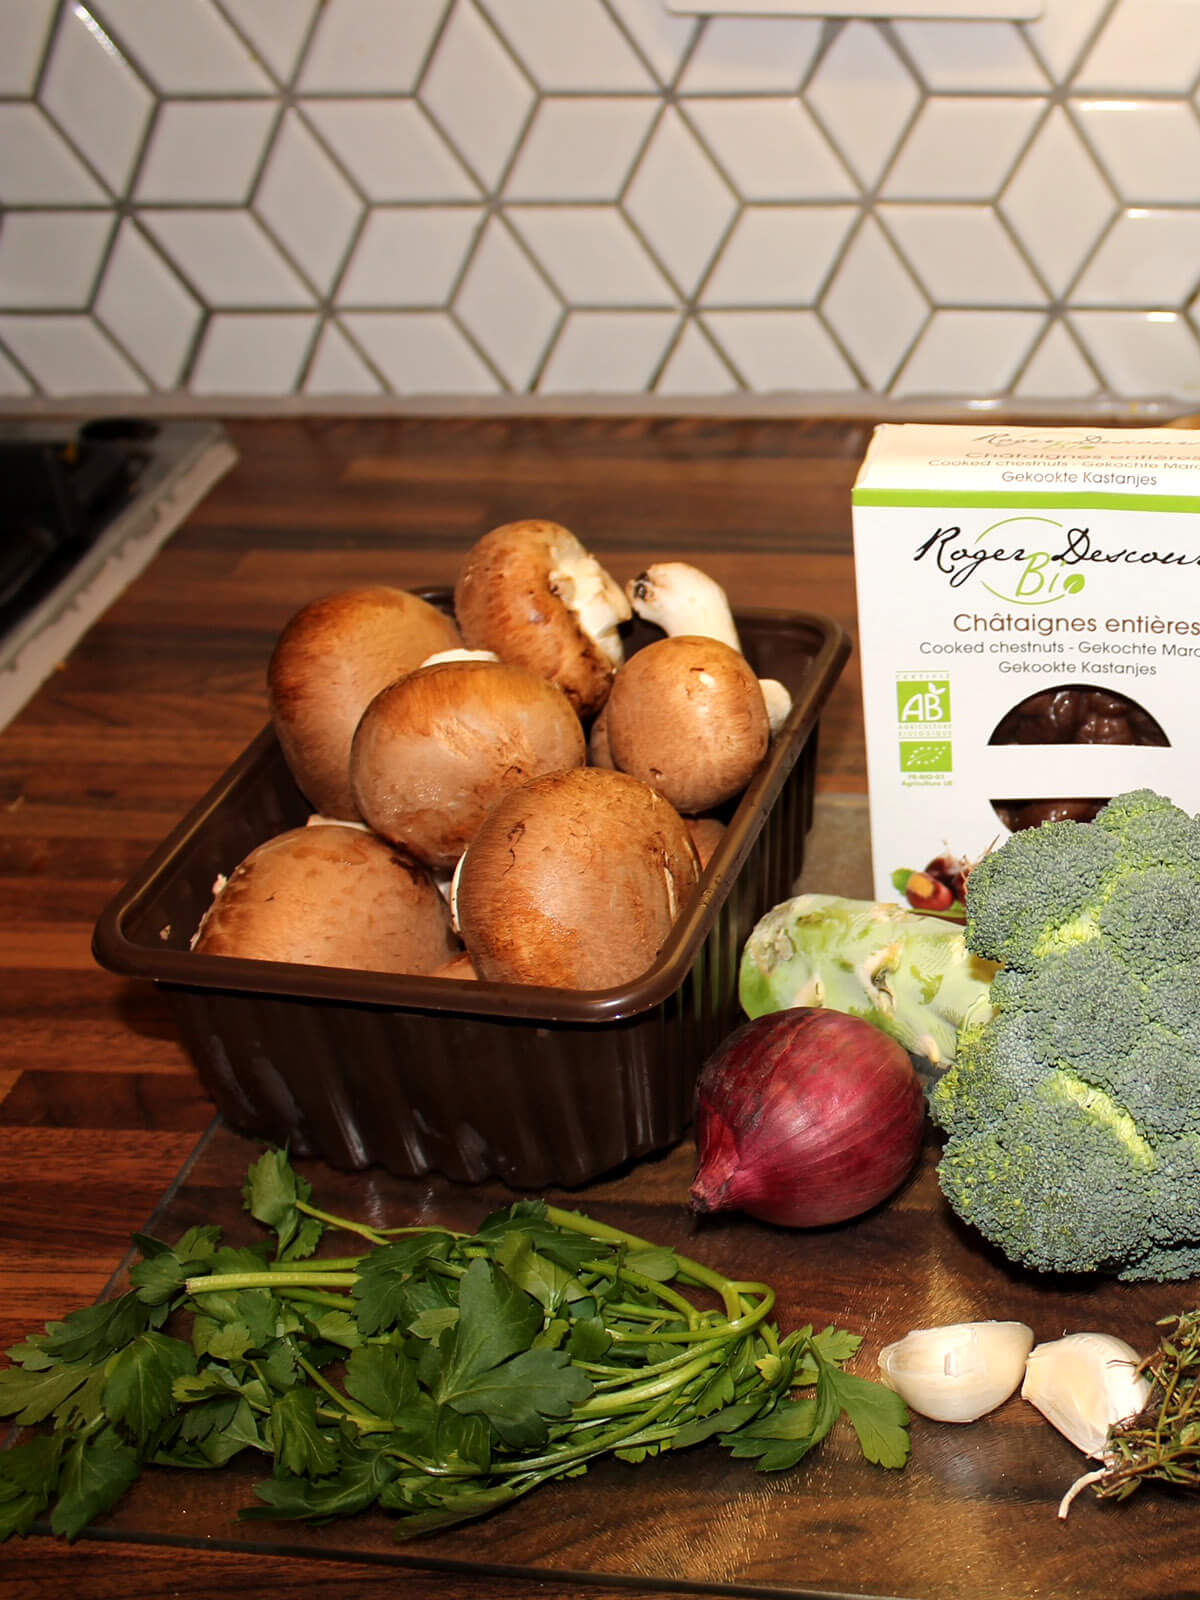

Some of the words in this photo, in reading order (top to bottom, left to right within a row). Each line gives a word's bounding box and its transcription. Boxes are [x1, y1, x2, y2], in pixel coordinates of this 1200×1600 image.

[1001, 471, 1078, 484] Gekookte
[1083, 471, 1158, 488] Kastanjes
[913, 526, 1027, 588] Roger
[953, 613, 1097, 636] Châtaignes
[1105, 615, 1200, 635] entières
[919, 641, 985, 655] Cooked
[989, 640, 1065, 654] chestnuts
[1078, 641, 1157, 656] Gekochte
[998, 660, 1077, 674] Gekookte
[1081, 661, 1157, 678] Kastanjes
[901, 692, 944, 721] AB
